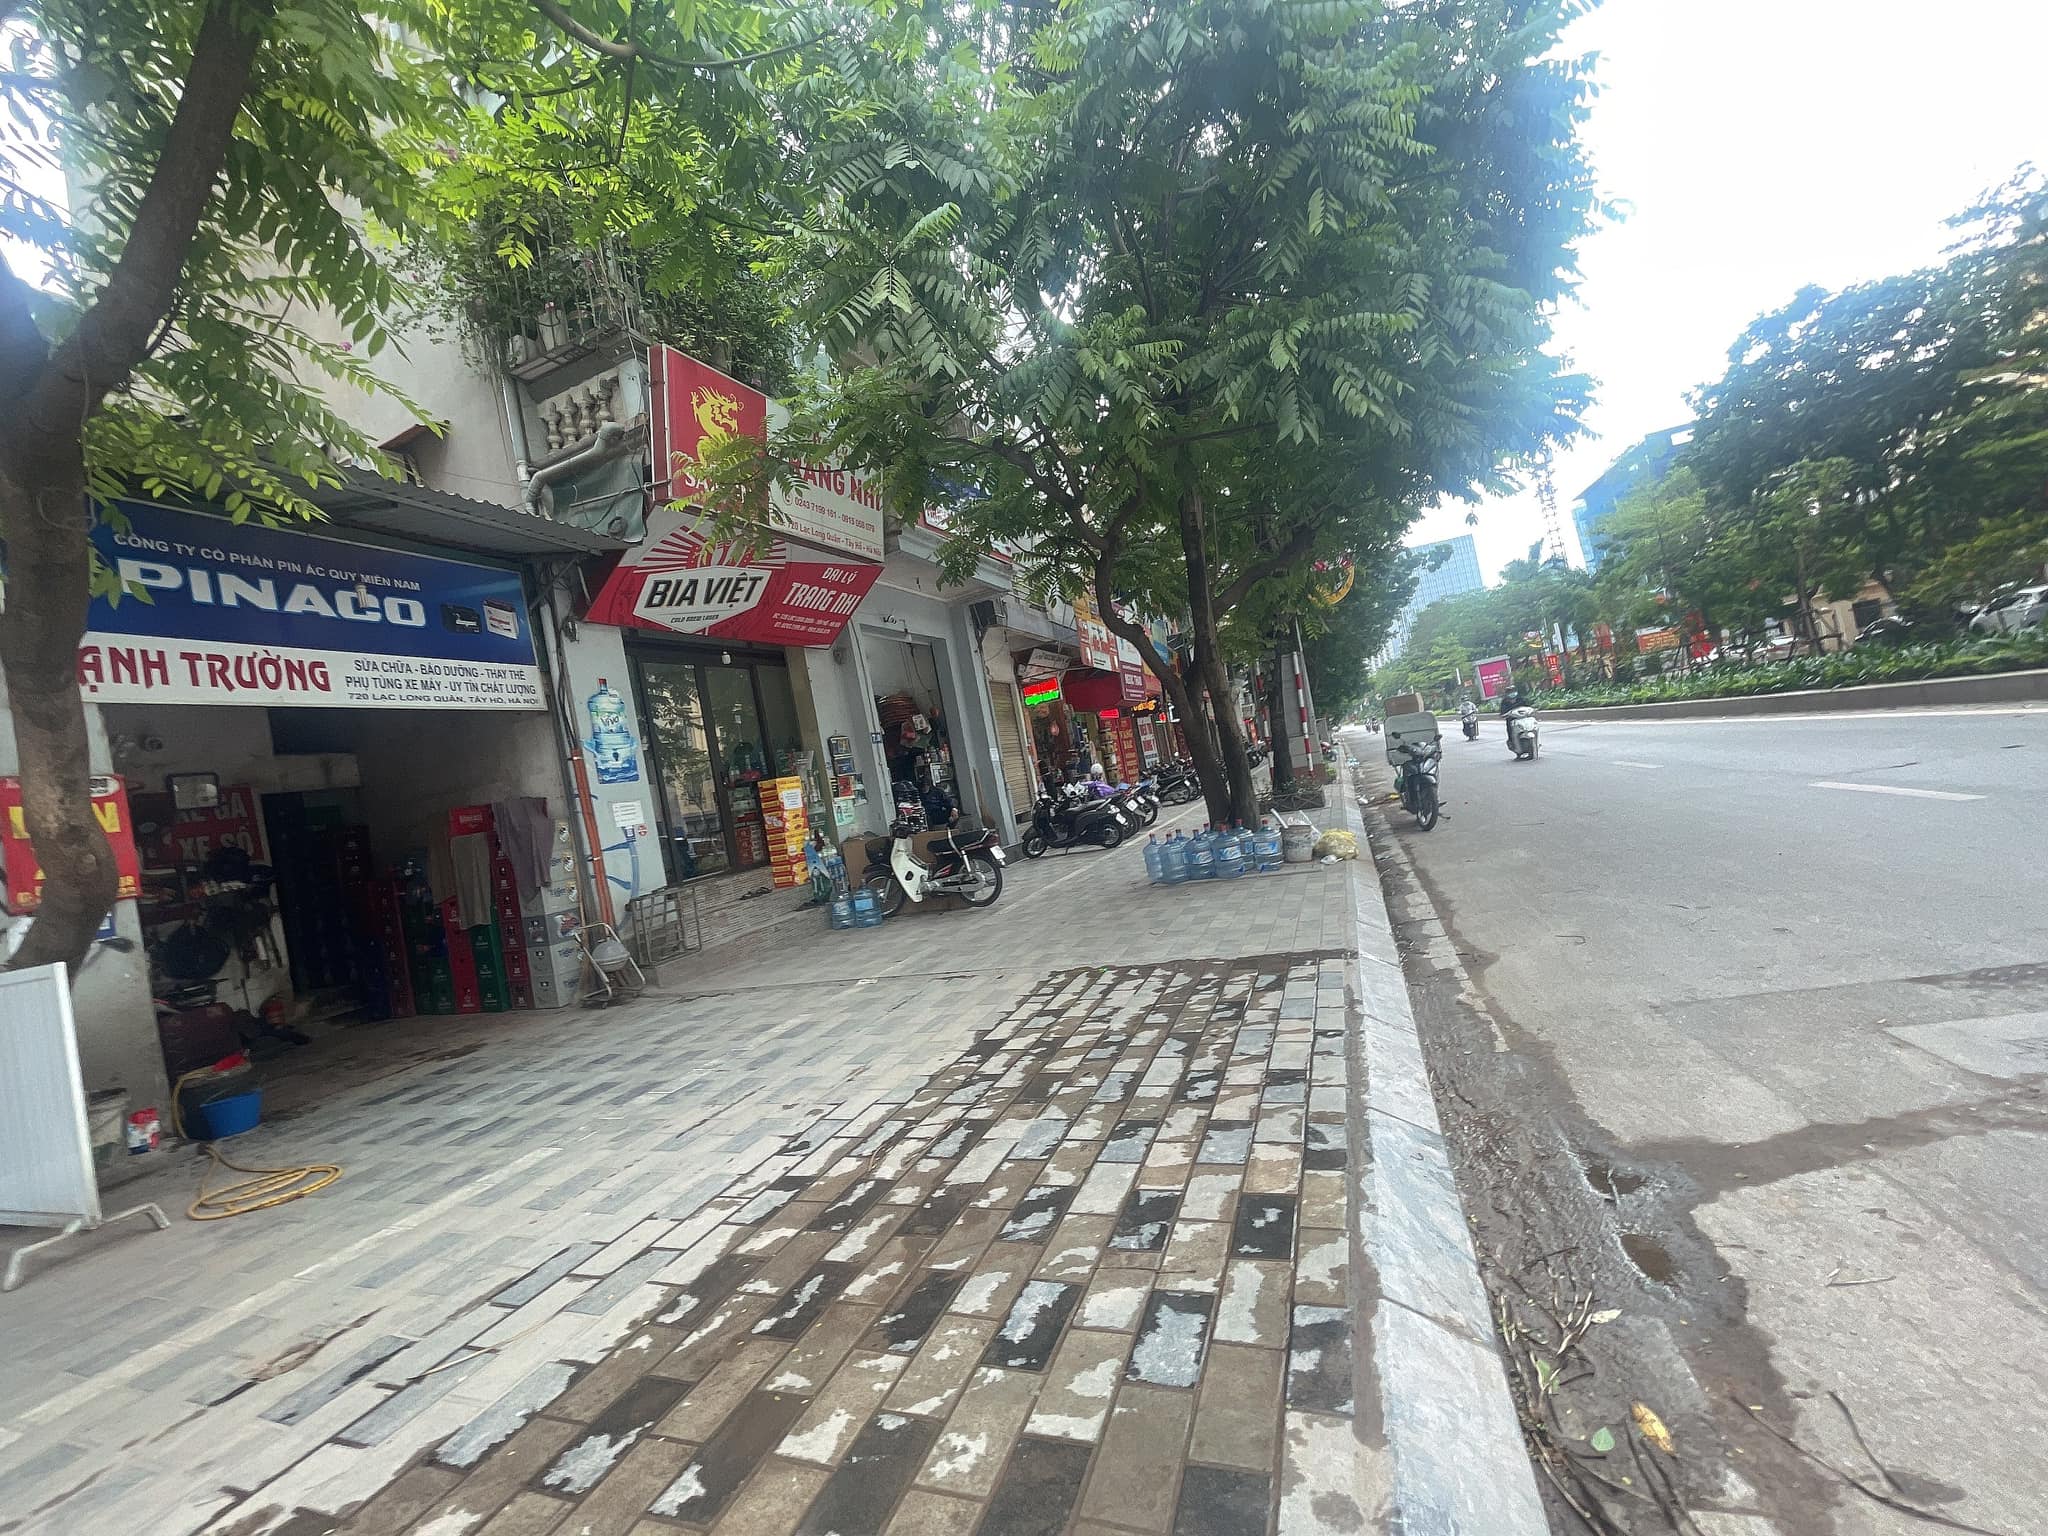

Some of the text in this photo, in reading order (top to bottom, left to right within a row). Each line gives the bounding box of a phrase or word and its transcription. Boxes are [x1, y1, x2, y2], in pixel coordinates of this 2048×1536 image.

[173, 543, 195, 557] TY
[278, 560, 302, 573] PIN
[394, 579, 421, 591] NAM
[822, 567, 858, 584] ĐẠI LÝ
[117, 558, 426, 627] PINACO
[644, 571, 764, 609] BIA VIỆT
[782, 582, 861, 616] TRANG NHI
[180, 650, 332, 693] TRƯỜNG
[345, 676, 369, 692] PHỤ
[373, 675, 402, 690] TÙNG
[405, 680, 419, 690] XE
[420, 679, 441, 692] MÁY
[449, 682, 462, 692] UY
[505, 683, 536, 697] LƯỢNG
[486, 668, 508, 680] THAY
[347, 692, 369, 700] 720
[399, 694, 431, 702] LONG
